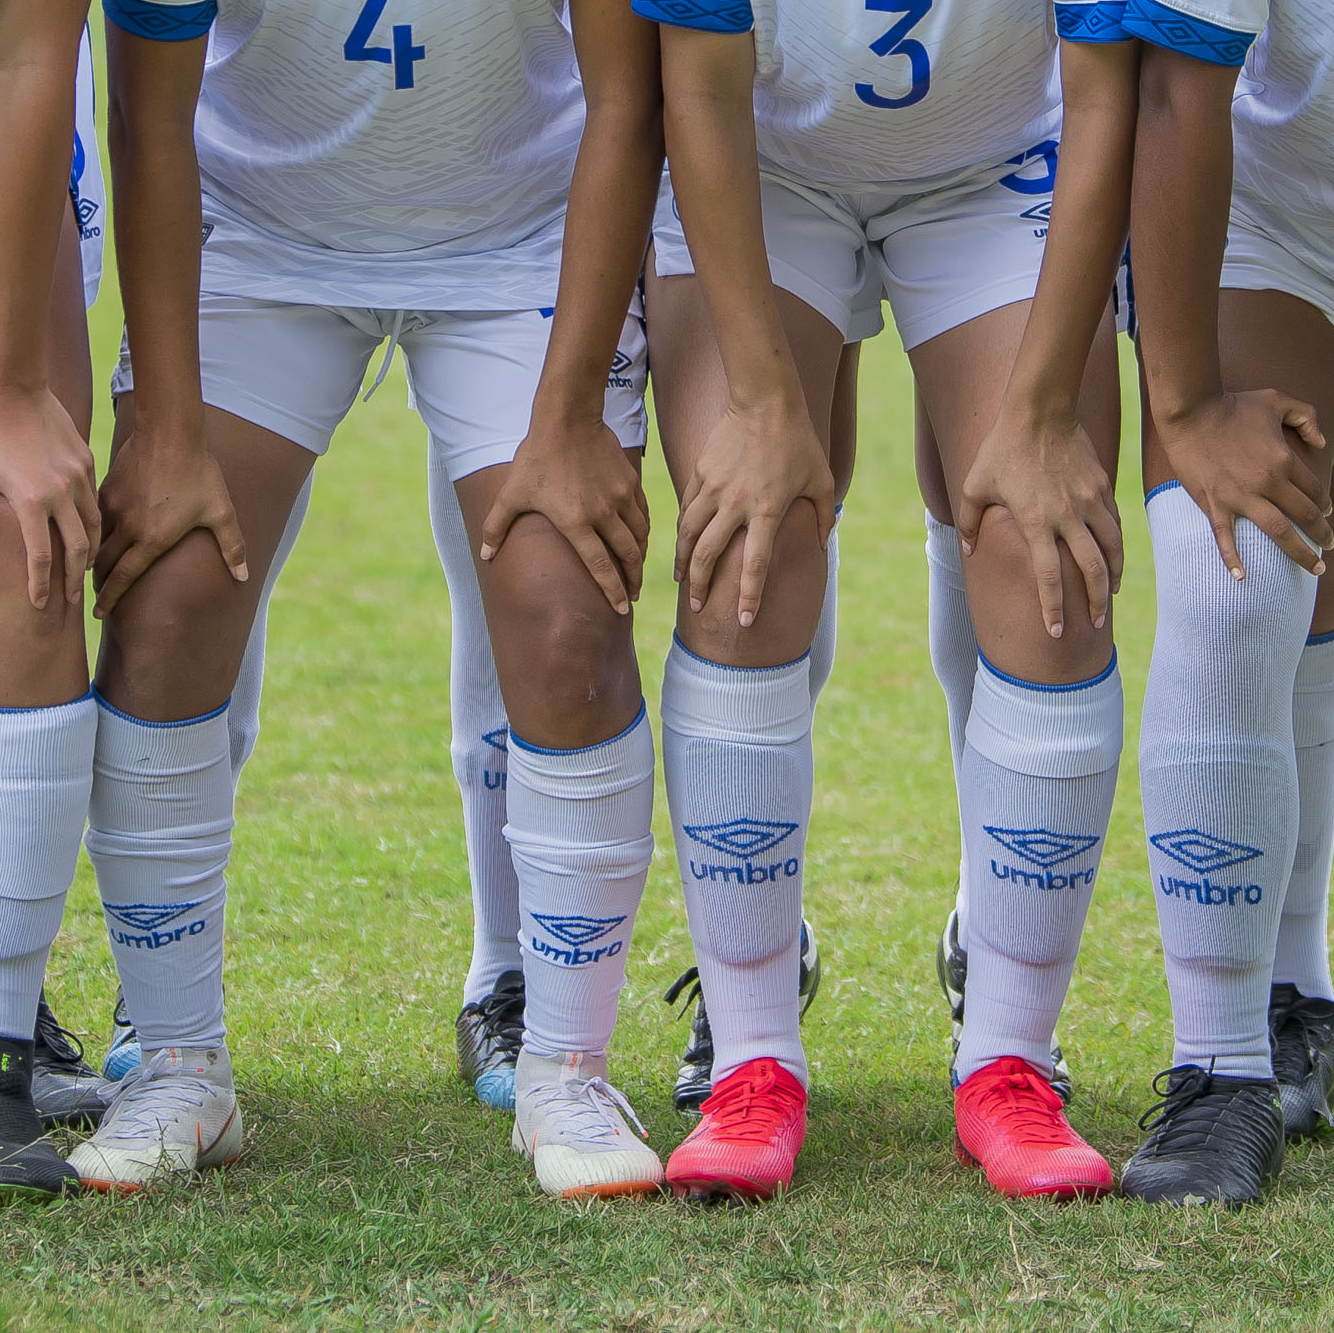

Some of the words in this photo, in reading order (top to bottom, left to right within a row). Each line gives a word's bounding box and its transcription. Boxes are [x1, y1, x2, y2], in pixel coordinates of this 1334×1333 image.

[607, 375, 633, 388] mbro
[690, 857, 798, 885] umbro
[991, 859, 1094, 890] umbro
[1159, 876, 1263, 906] umbro
[110, 919, 206, 950] umbro
[532, 935, 623, 966] umbro
